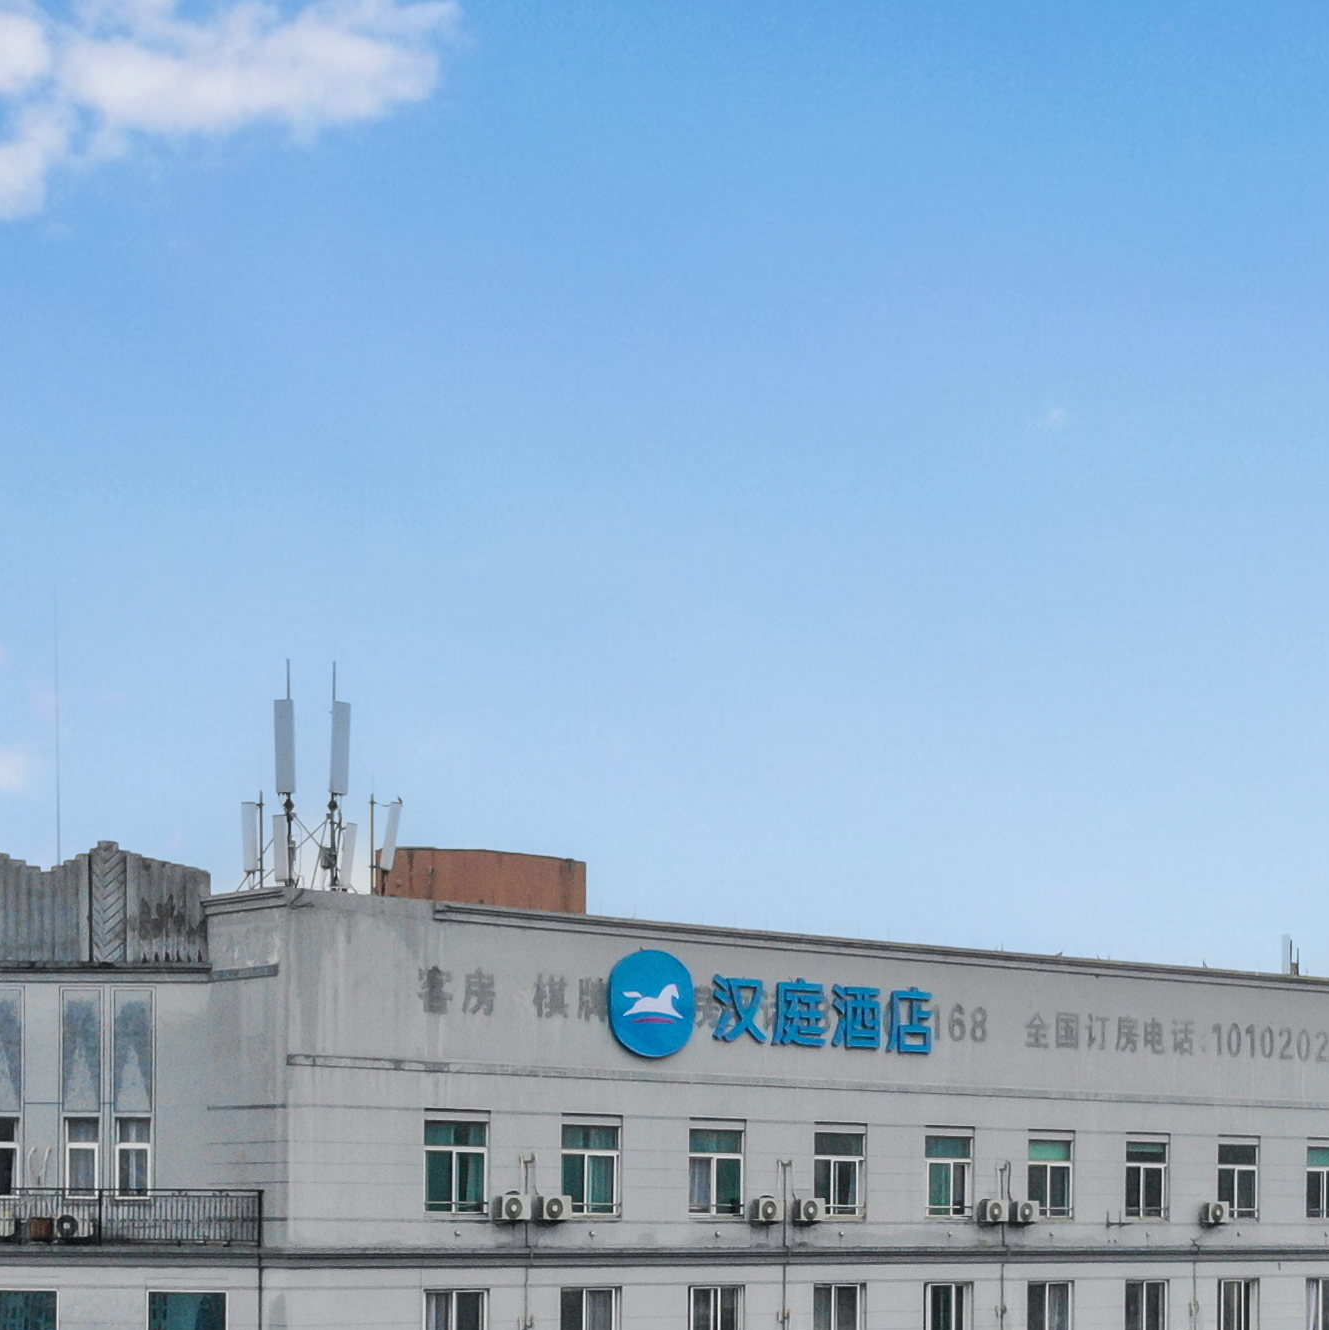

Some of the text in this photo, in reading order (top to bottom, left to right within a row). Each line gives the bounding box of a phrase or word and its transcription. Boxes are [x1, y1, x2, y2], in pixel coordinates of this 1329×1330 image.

[418, 966, 496, 1016] 客房
[712, 974, 933, 1055] 汉庭酒店
